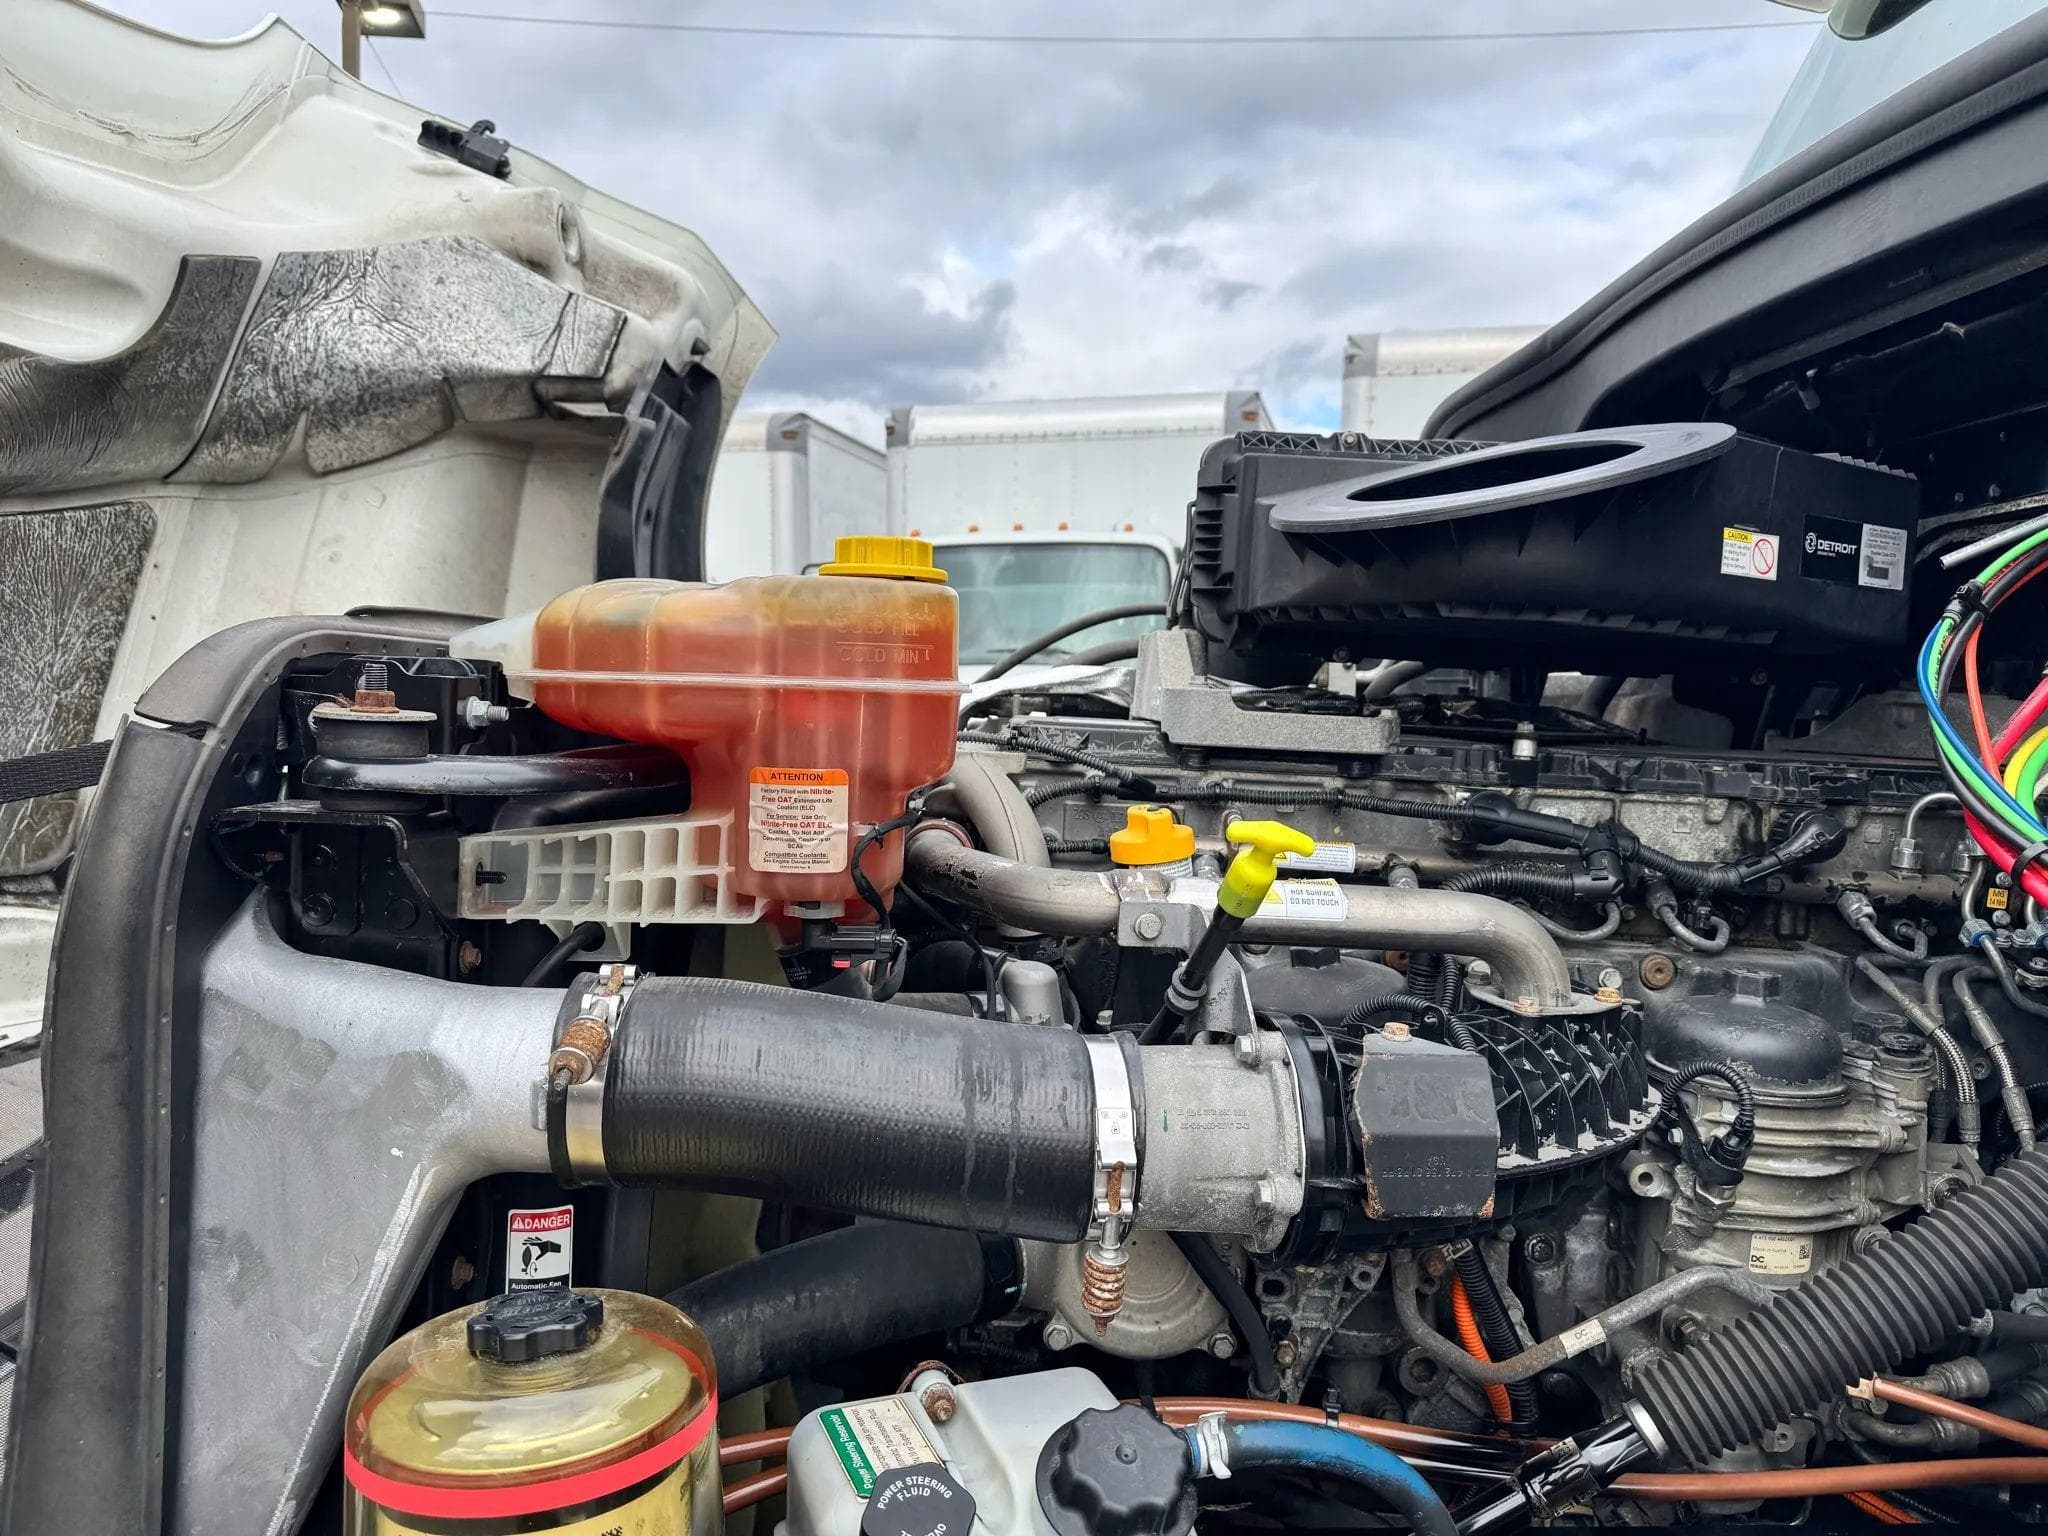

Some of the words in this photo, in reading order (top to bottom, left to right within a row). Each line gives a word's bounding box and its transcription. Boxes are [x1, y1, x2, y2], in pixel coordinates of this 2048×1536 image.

[1727, 531, 1749, 541] CAUTION
[1817, 539, 1858, 555] DETROIT
[893, 622, 920, 636] FILL
[840, 647, 886, 662] COLD
[894, 649, 919, 664] MIN
[770, 772, 824, 781] ATTENTION
[760, 820, 798, 828] Nitrite-Free
[1992, 890, 2005, 898] M6
[1302, 898, 1315, 906] NOT
[1317, 898, 1340, 906] TOUCH
[525, 1214, 570, 1229] DANGER
[1750, 1254, 1765, 1264] DC
[511, 1282, 547, 1290] Automatic
[1574, 1328, 1588, 1340] DC
[830, 1415, 850, 1442] Reservoir
[845, 1442, 864, 1468] Steering
[858, 1468, 873, 1488] Power
[877, 1480, 904, 1510] POWER
[906, 1476, 953, 1498] STEERING
[897, 1486, 930, 1501] FLUID
